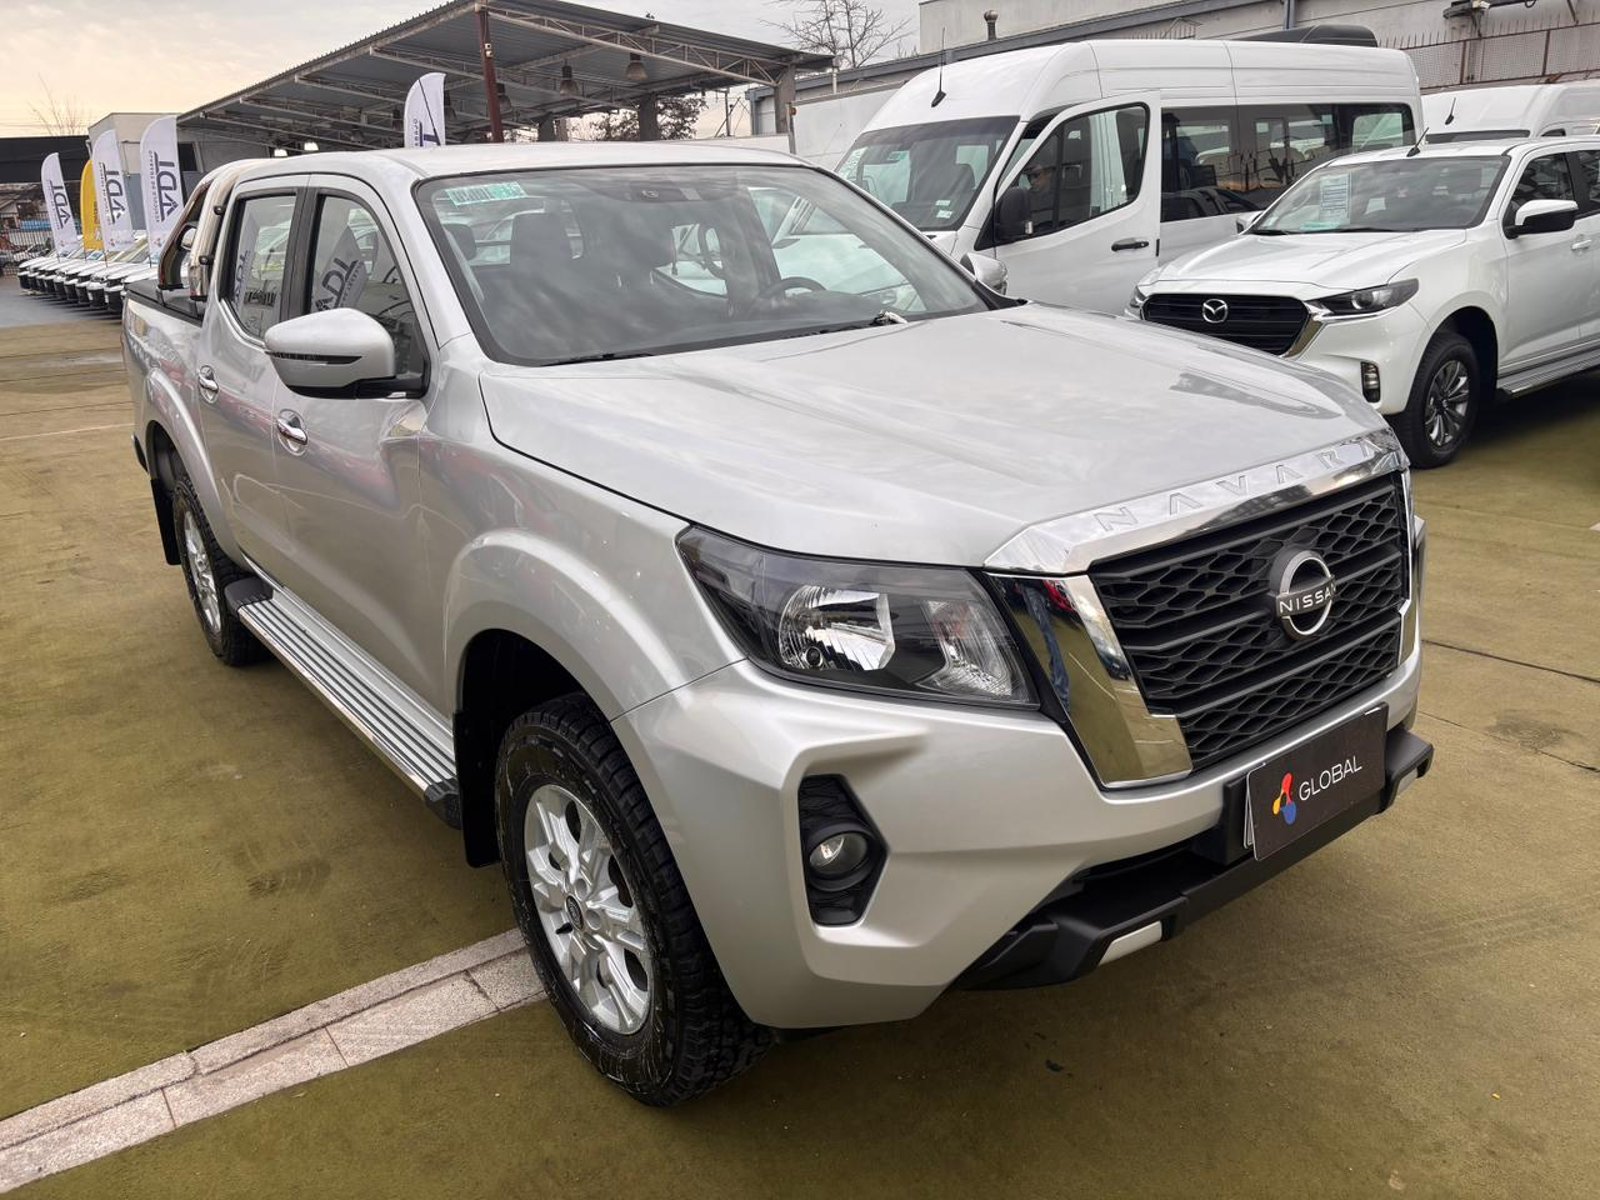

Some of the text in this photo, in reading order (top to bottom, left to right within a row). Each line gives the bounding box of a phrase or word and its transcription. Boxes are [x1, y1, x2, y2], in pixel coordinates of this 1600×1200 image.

[1093, 439, 1382, 531] NAVARA
[1279, 582, 1336, 614] NISSAN
[1298, 755, 1363, 801] GLOBAL
